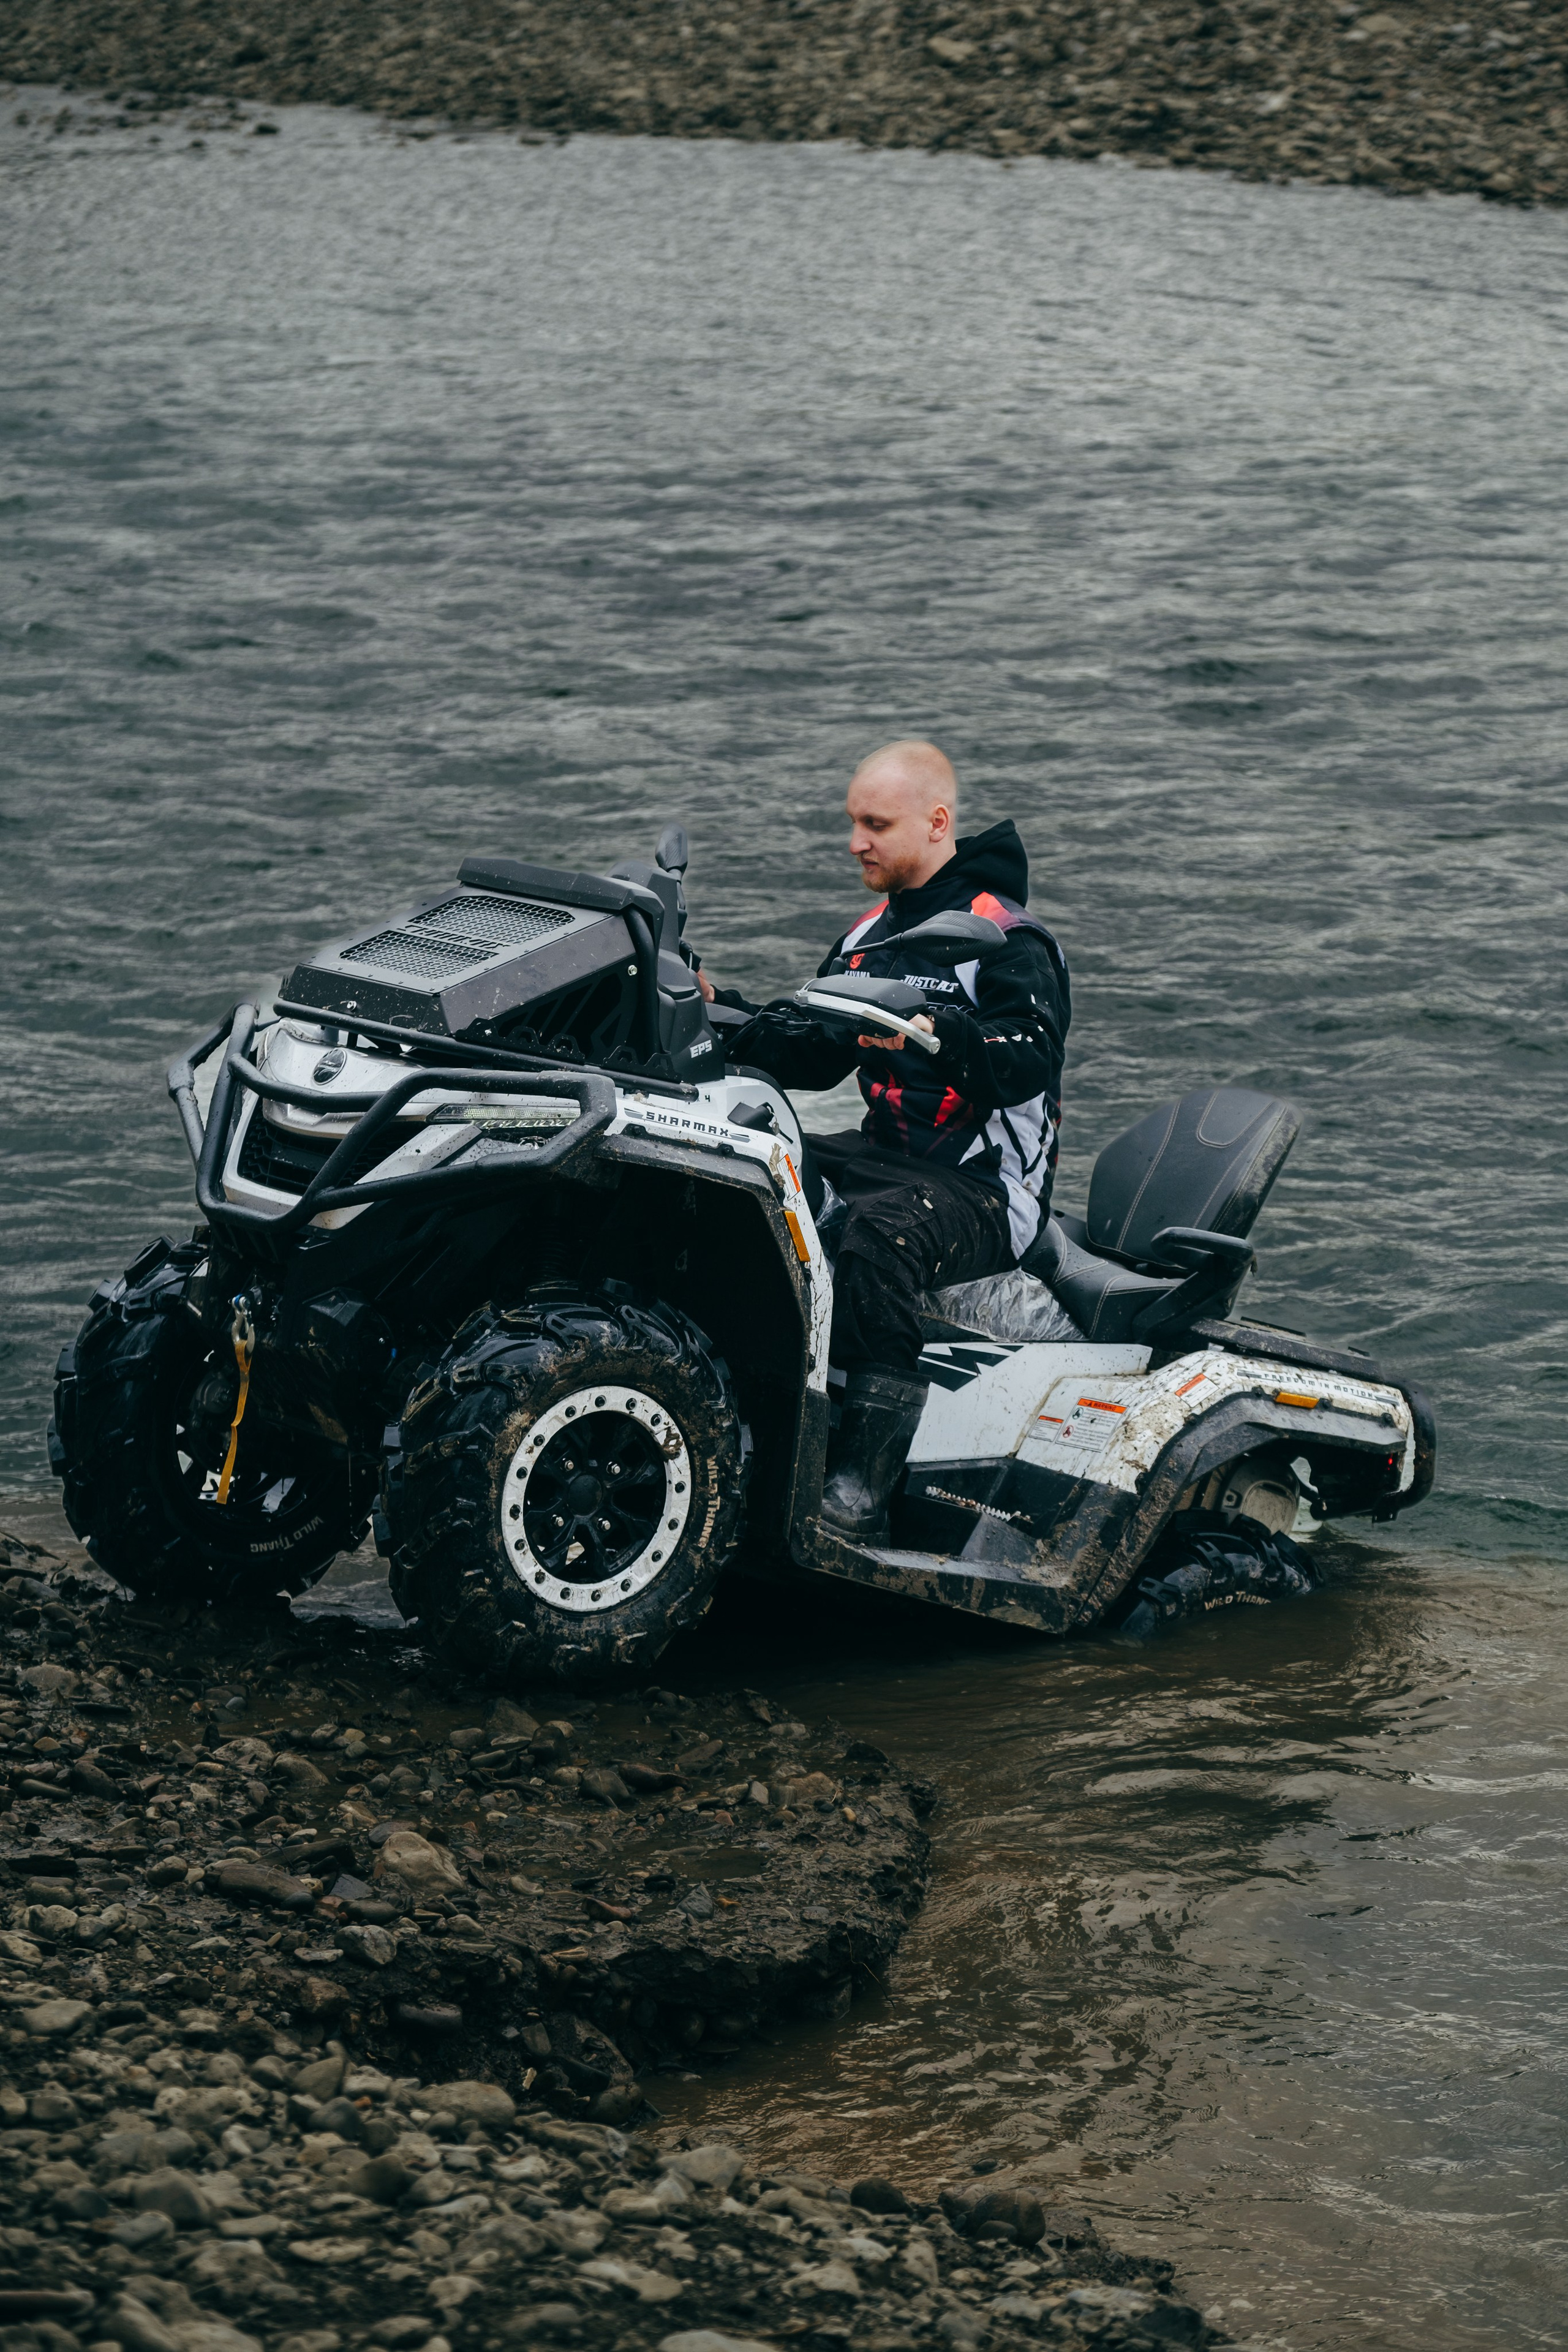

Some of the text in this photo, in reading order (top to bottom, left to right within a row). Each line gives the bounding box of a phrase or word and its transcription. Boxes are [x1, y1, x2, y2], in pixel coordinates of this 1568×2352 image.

[900, 974, 960, 993] JUSTCAT
[689, 1039, 712, 1058] EPS
[646, 1111, 729, 1137] SHARMAX
[1264, 1373, 1316, 1386] FREEDOM
[1334, 1385, 1373, 1398] MOTION
[1093, 1401, 1117, 1411] WARNING
[697, 1455, 721, 1549] WILD THANG
[250, 1516, 324, 1553] WILD THANG
